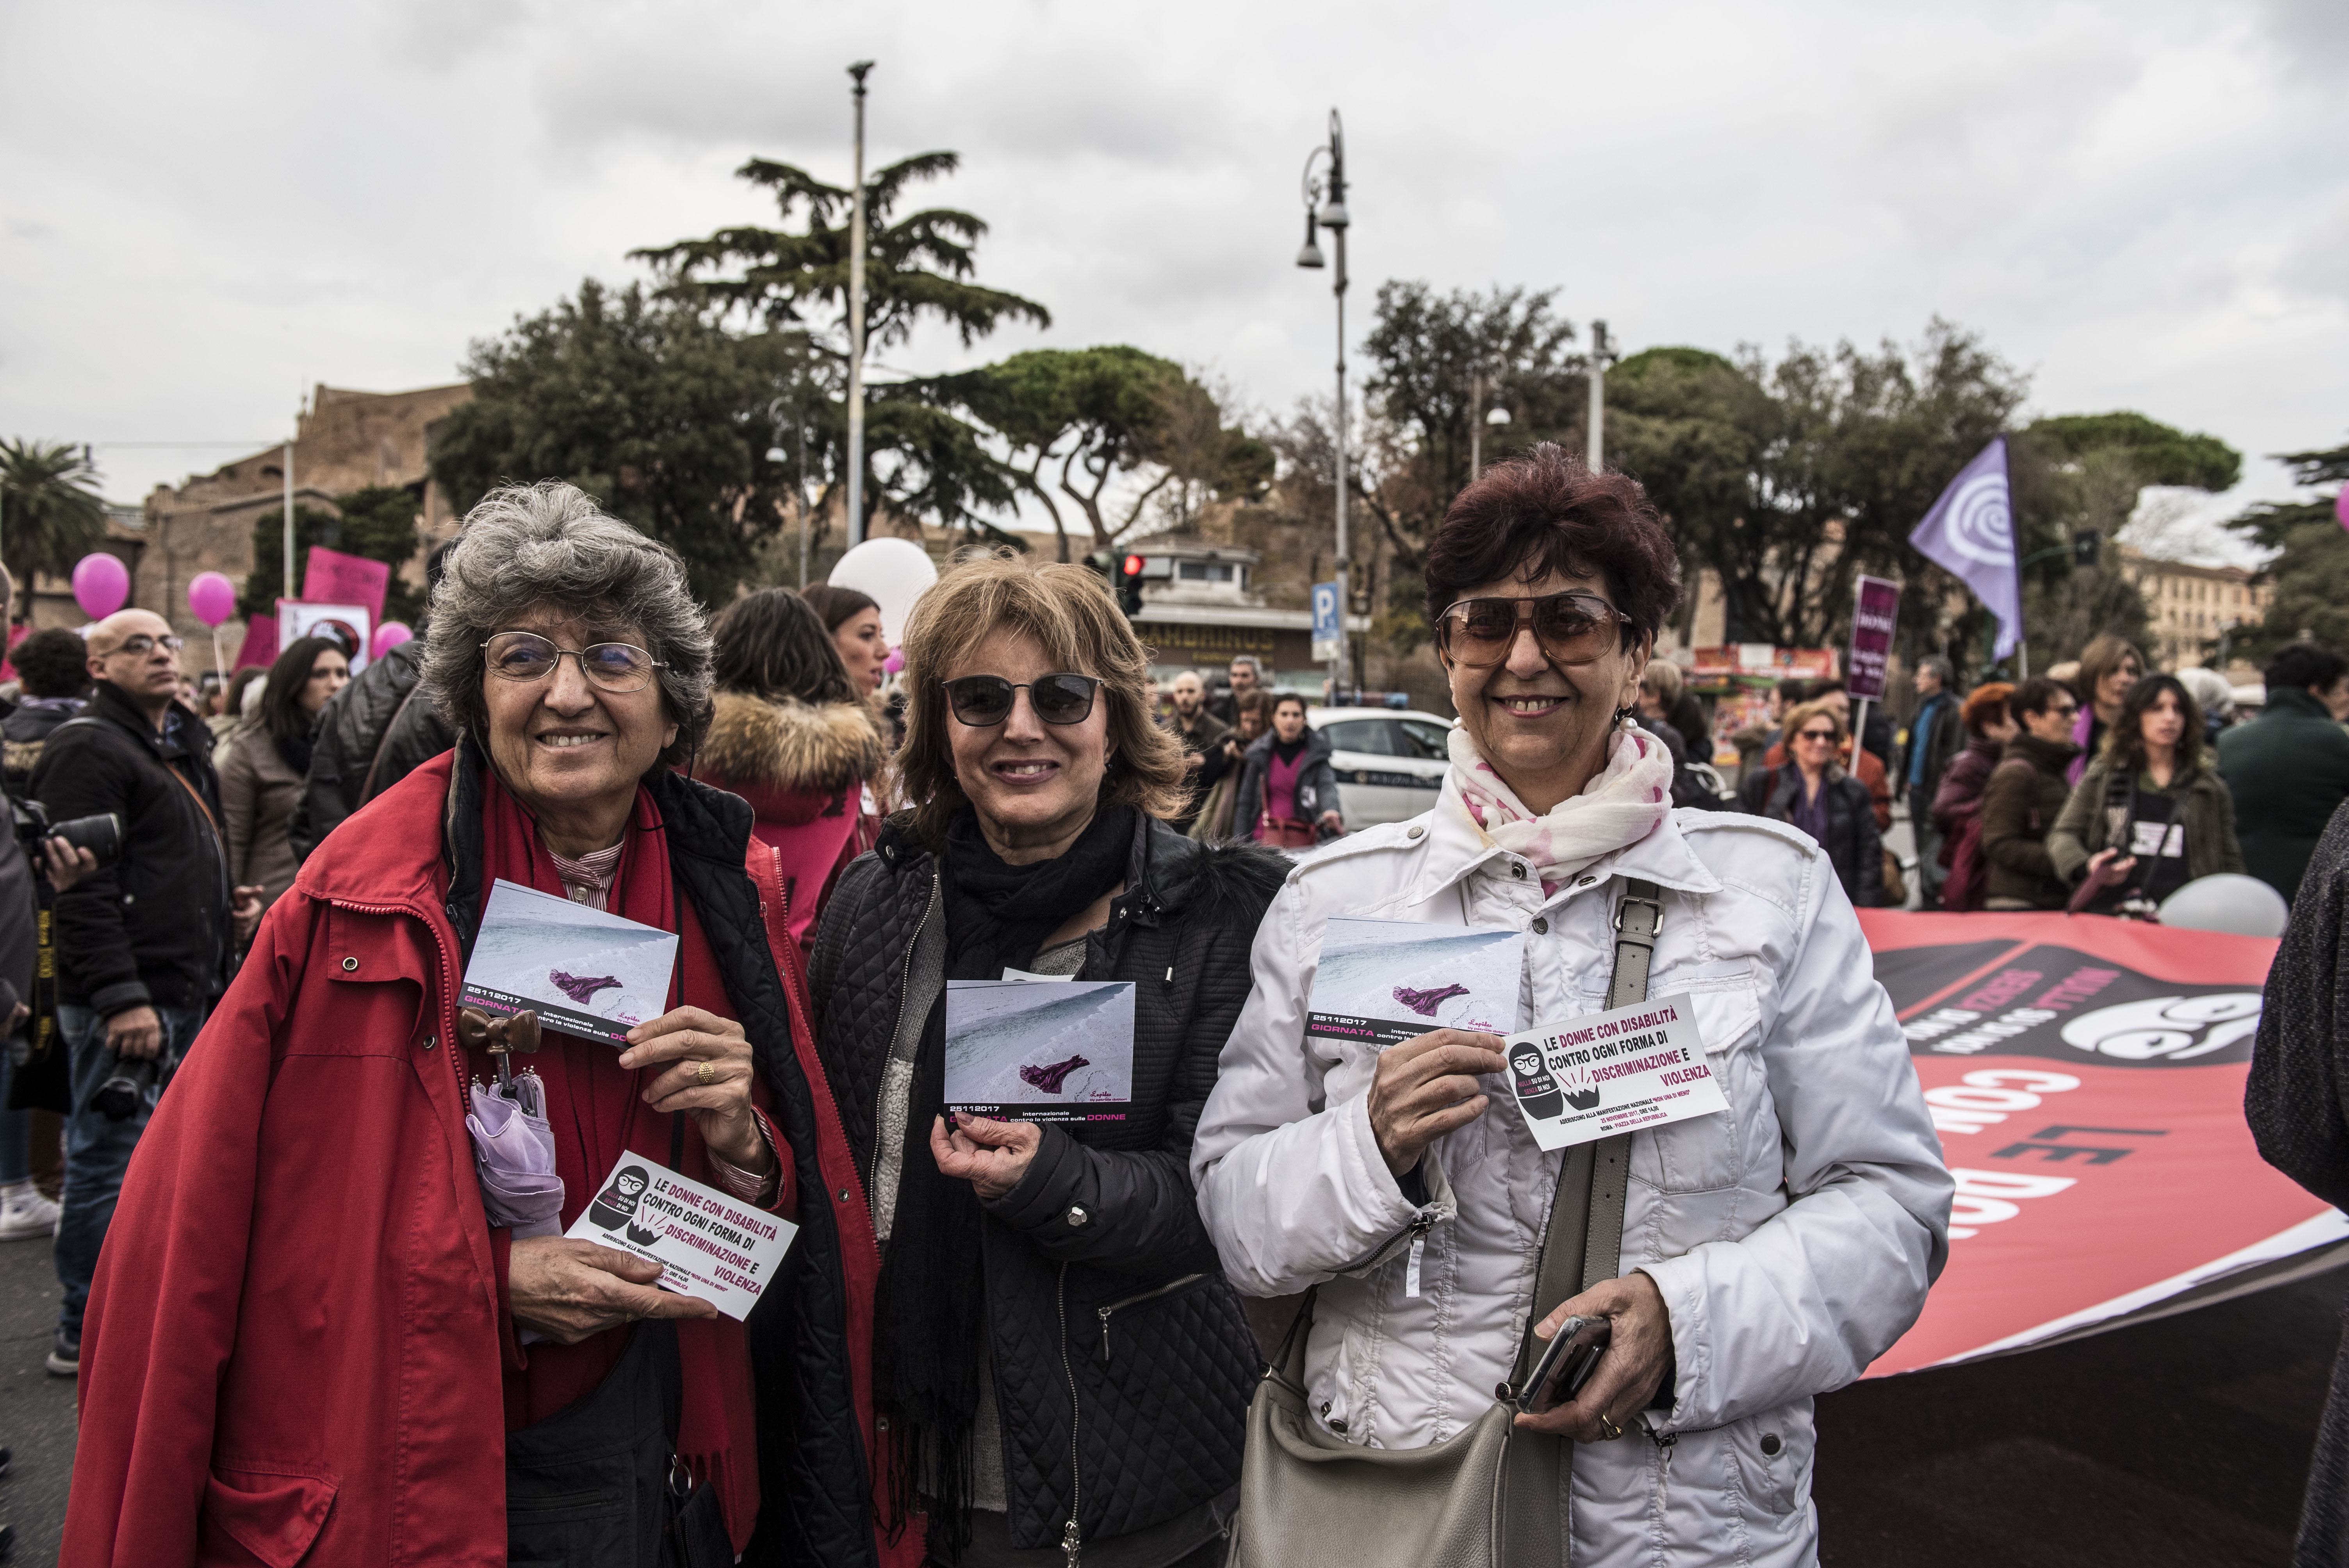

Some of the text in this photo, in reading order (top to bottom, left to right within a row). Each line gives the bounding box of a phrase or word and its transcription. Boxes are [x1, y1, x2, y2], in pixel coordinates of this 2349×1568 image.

[1317, 590, 1334, 628] P
[467, 986, 521, 1003] 25112017
[544, 1011, 593, 1027] internazionale
[1313, 1015, 1367, 1026] 25112017
[1468, 1019, 1492, 1028] Lapides
[563, 1022, 592, 1033] violenza
[1312, 1024, 1374, 1037] GIORNATA
[1543, 1005, 1678, 1052] LE DONNE CON DISABILITÀ
[1548, 1030, 1668, 1071] CONTRO OGNI FORMA DI
[1591, 1048, 1690, 1083] DISCRIMINAZIONE E
[1518, 1079, 1532, 1088] NULLA
[1659, 1064, 1712, 1087] VIOLENZA
[1524, 1087, 1538, 1095] SENZA
[1559, 1114, 1586, 1125] ADERISCONO
[1597, 1103, 1631, 1116] MANIFESTAZIONE
[1630, 1098, 1653, 1108] NAZIONALE
[1606, 1112, 1629, 1122] NOVEMBRE
[1643, 1112, 1668, 1122] REPUBBLICA
[604, 1197, 617, 1207] SENZA
[606, 1190, 619, 1199] NULLA
[654, 1178, 778, 1242] LE DONNE CON DISABILITÀ
[643, 1193, 756, 1251] CONTRO OGNI FORMA DI
[602, 1233, 627, 1247] ADERISCONO
[636, 1248, 670, 1266] MANIFESTAZIONE
[668, 1263, 691, 1276] NAZIONALE
[664, 1224, 760, 1275] DISCRIMINAZIONE E
[664, 1276, 688, 1290] REPUBBLICA
[714, 1265, 762, 1296] VIOLENZA
